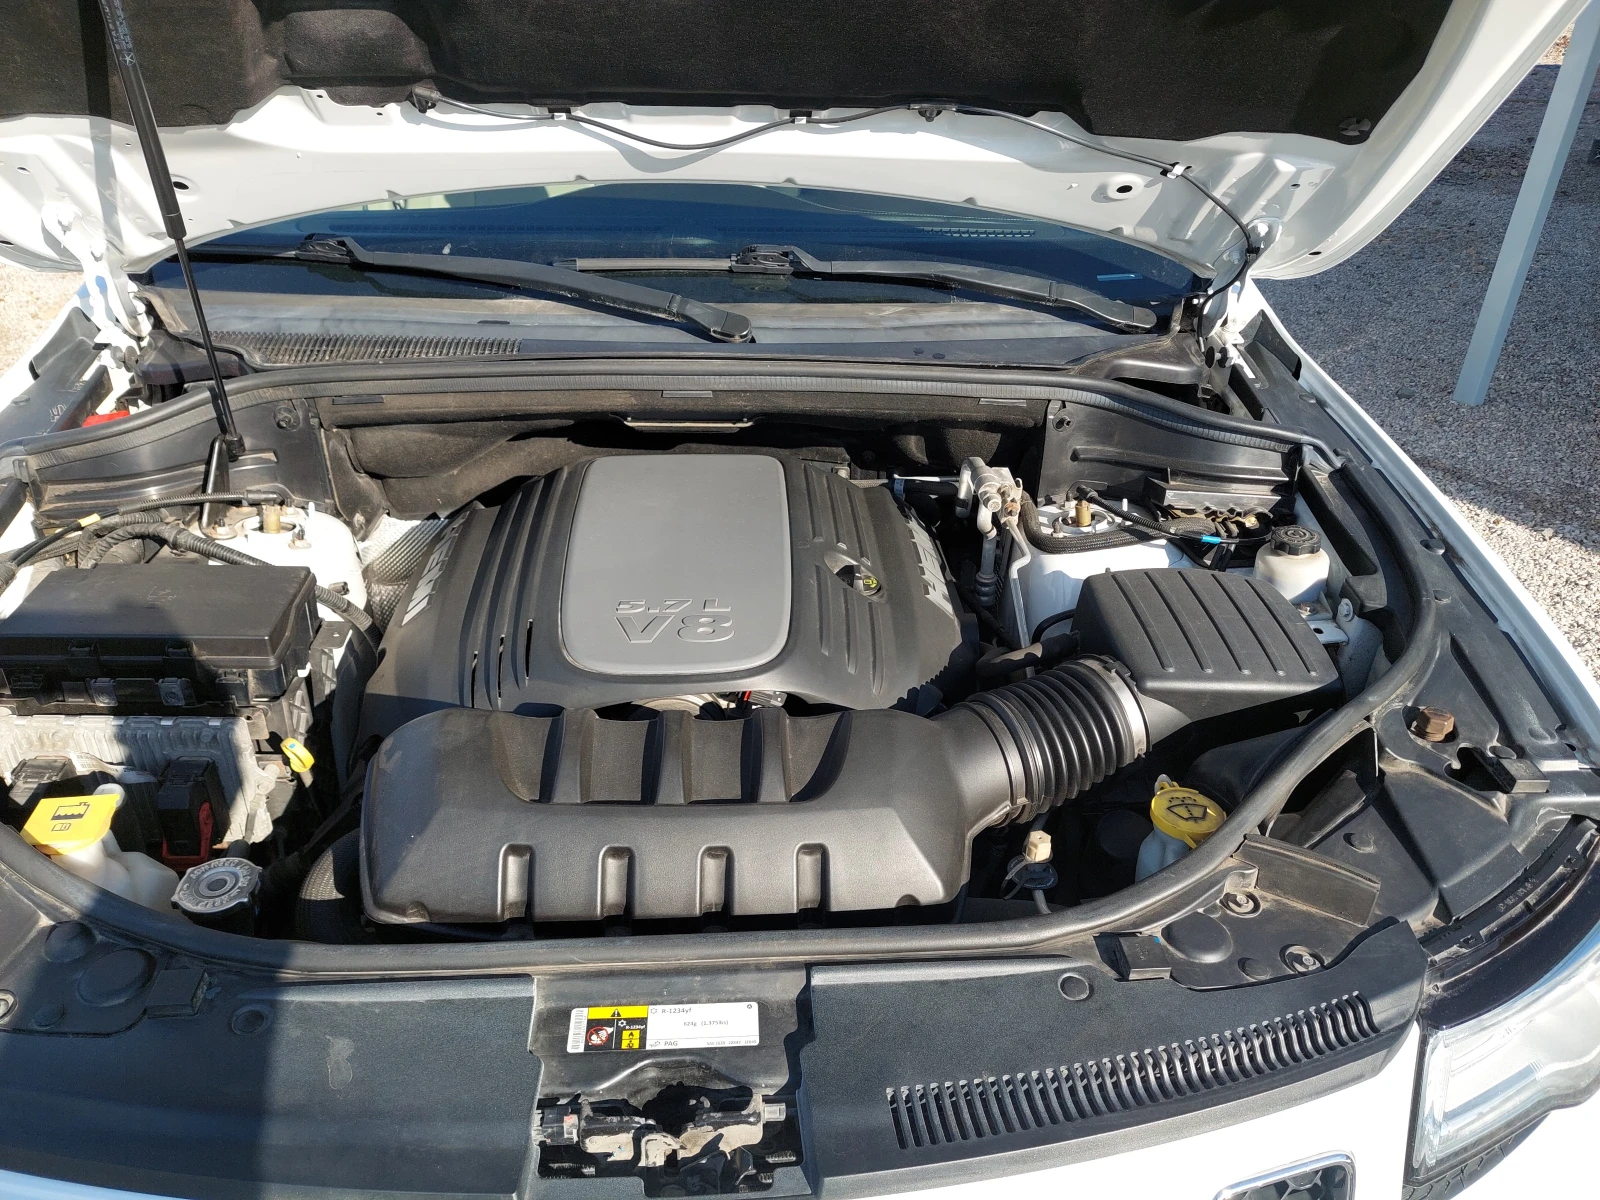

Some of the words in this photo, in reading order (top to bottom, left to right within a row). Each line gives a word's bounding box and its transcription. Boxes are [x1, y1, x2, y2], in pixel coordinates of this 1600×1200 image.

[401, 511, 470, 626] HEMI
[616, 599, 692, 613] 5.7
[703, 599, 731, 612] L
[615, 614, 735, 643] V8
[661, 1007, 692, 1015] R-1234yf
